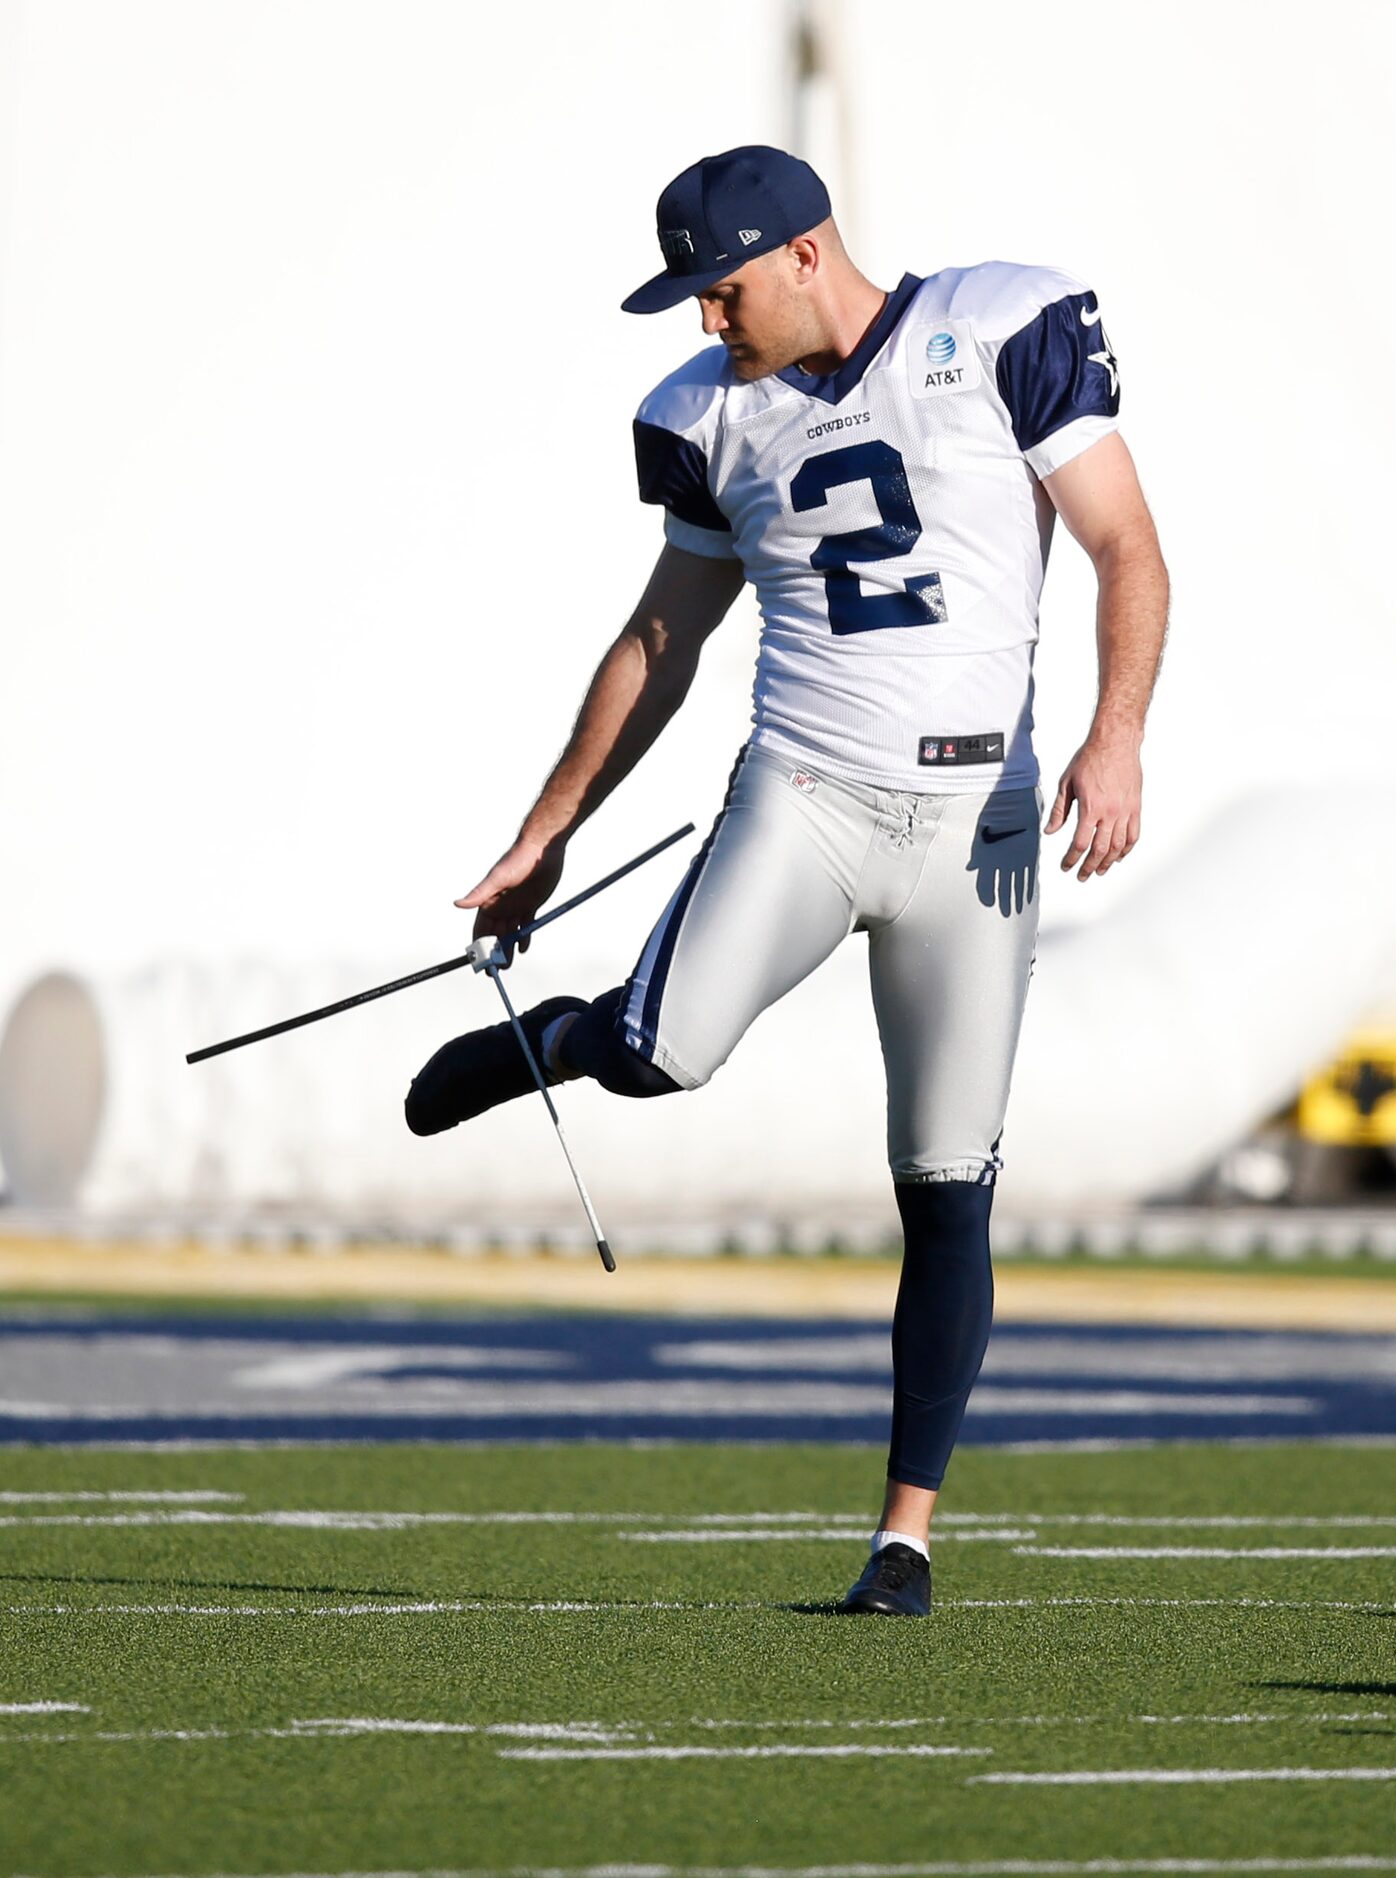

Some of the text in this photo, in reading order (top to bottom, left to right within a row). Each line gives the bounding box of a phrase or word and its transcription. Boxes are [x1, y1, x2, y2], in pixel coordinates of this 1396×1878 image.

[925, 368, 964, 388] AT&T
[807, 411, 871, 440] COWBOYS
[790, 439, 948, 636] 2
